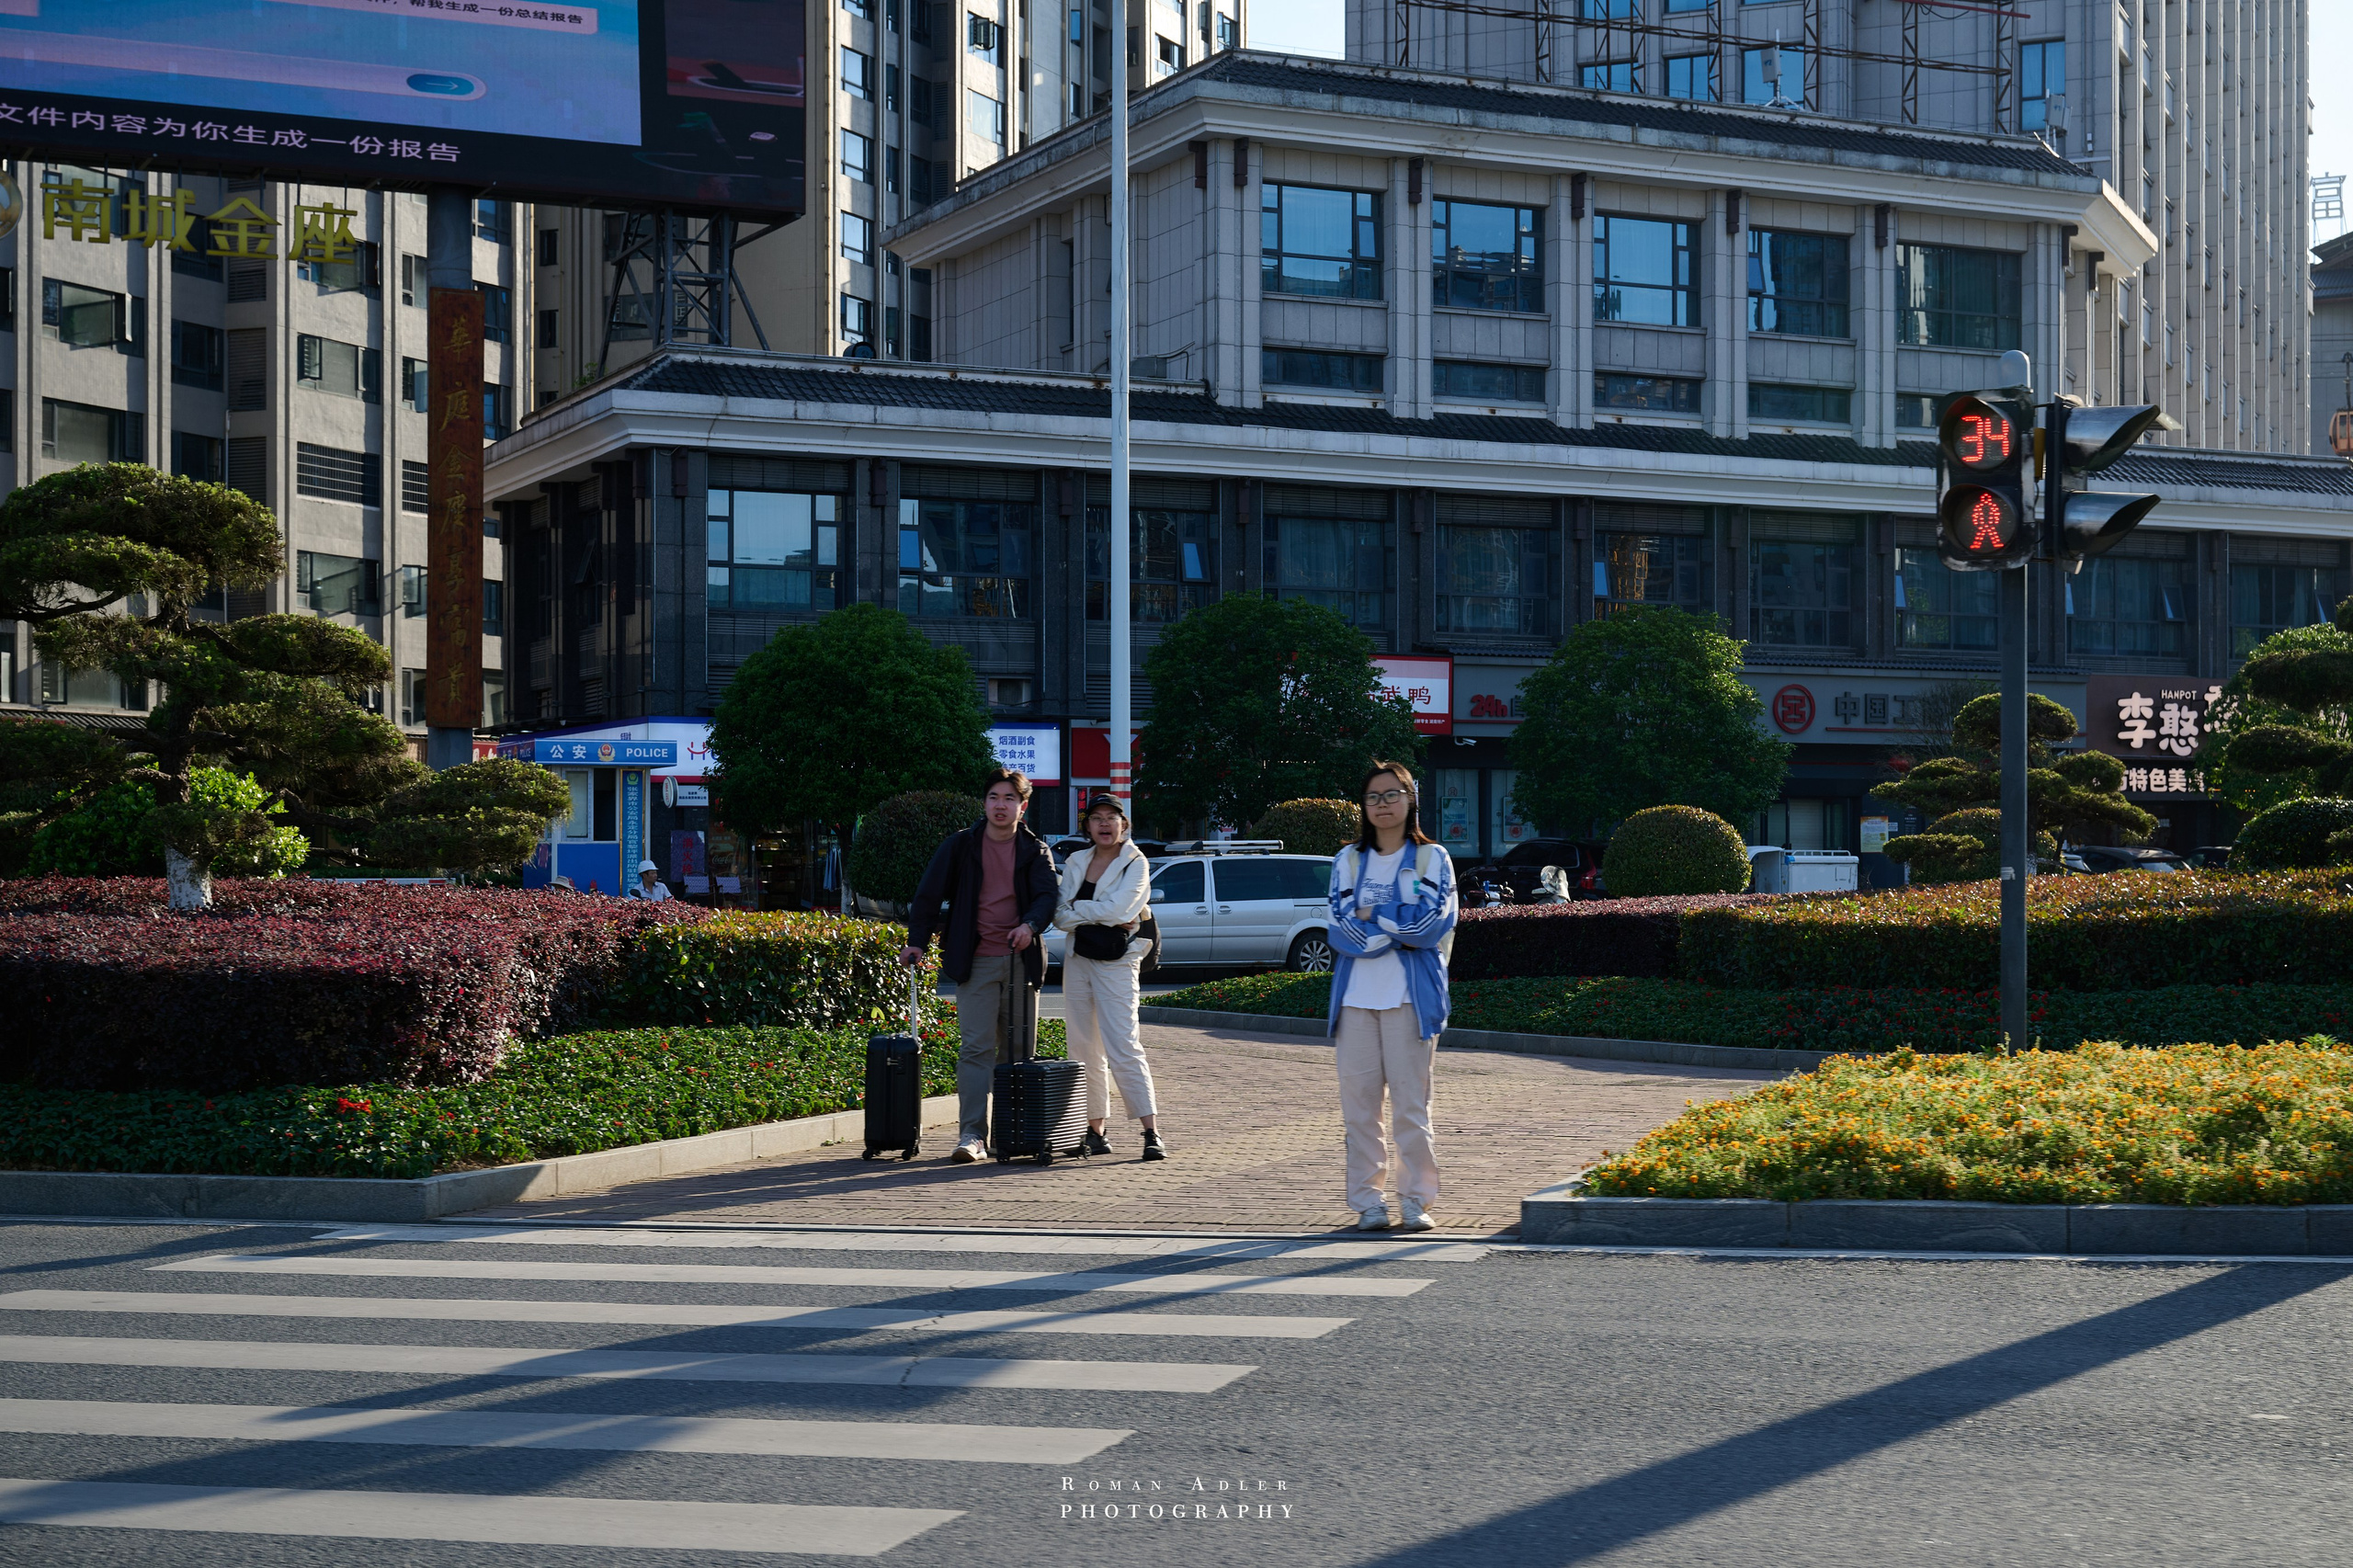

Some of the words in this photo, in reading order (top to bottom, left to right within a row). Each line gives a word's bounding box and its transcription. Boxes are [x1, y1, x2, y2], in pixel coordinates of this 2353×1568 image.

[40, 178, 358, 265] 南城金座
[1961, 415, 2009, 462] 34
[2161, 689, 2197, 700] HANPOT
[998, 735, 1035, 745] 烟酒副食
[550, 744, 587, 759] 公安
[626, 747, 668, 758] POLICE
[998, 749, 1035, 759] 零食水果
